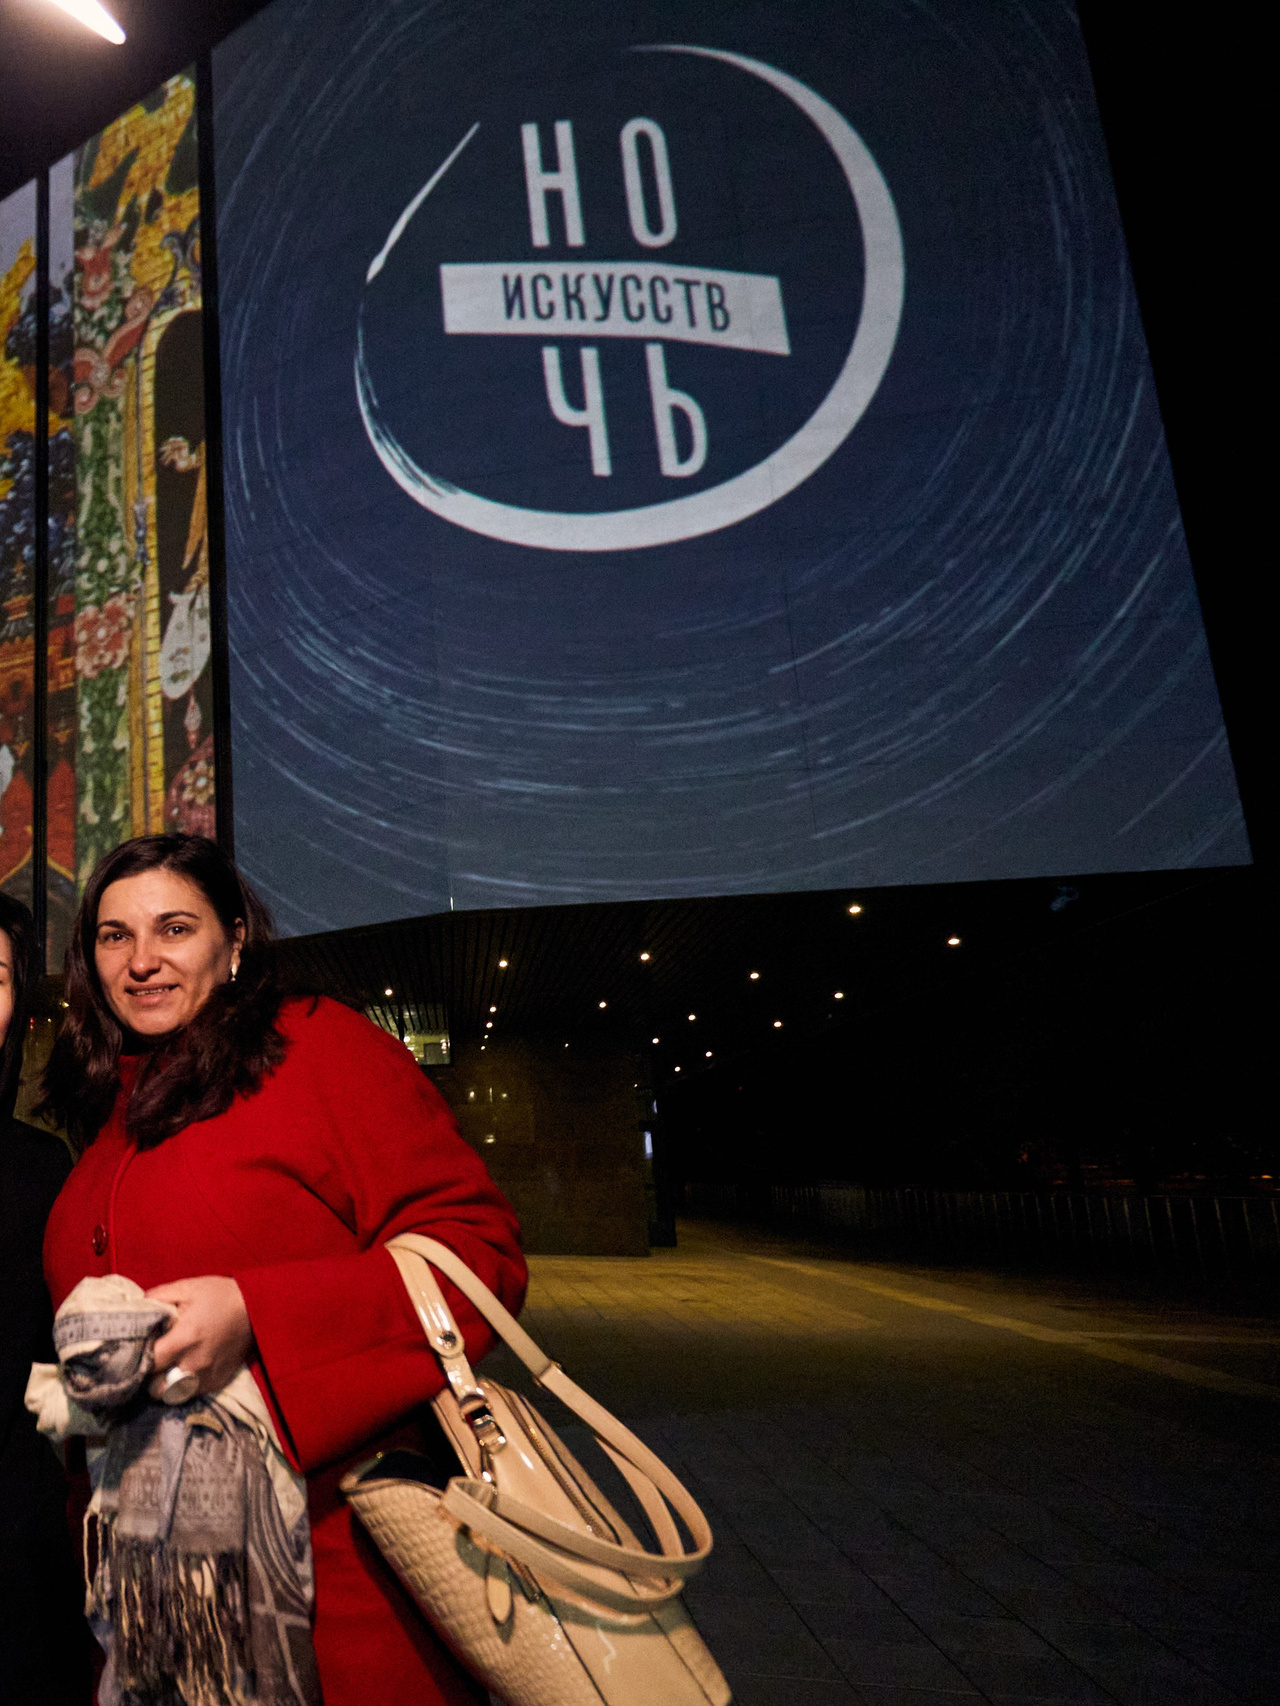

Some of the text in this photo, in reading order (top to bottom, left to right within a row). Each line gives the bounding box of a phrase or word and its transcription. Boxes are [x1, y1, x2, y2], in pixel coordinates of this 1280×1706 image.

[521, 116, 678, 248] НО
[502, 272, 731, 332] ИСКУССТВ
[542, 343, 708, 477] ЧЬ
